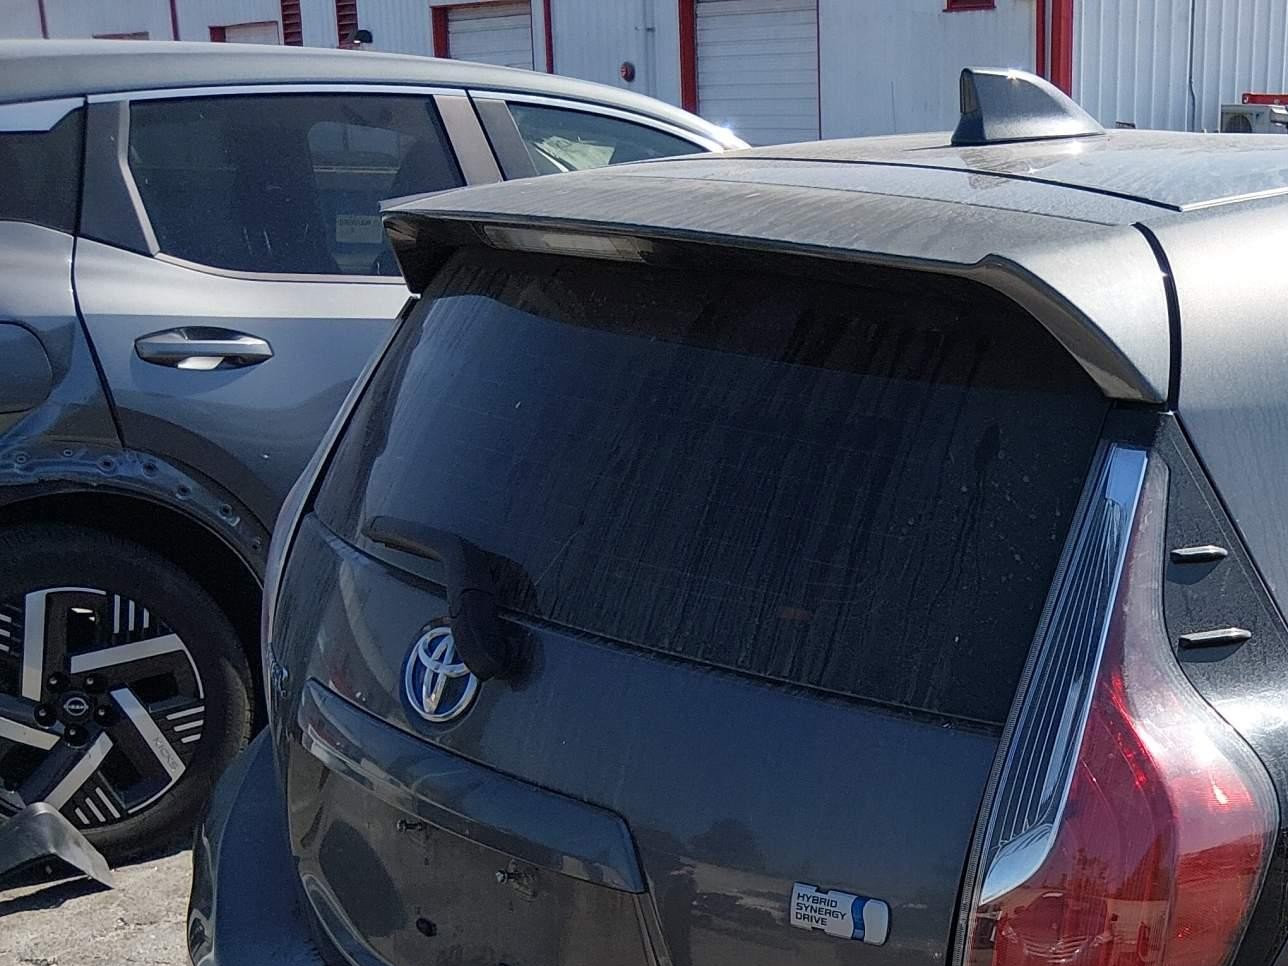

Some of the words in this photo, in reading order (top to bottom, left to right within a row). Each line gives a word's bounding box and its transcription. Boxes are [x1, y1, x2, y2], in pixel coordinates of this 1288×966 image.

[797, 893, 838, 908] HYBRID
[795, 912, 828, 926] DRIVE
[796, 903, 846, 920] SYNERGY
